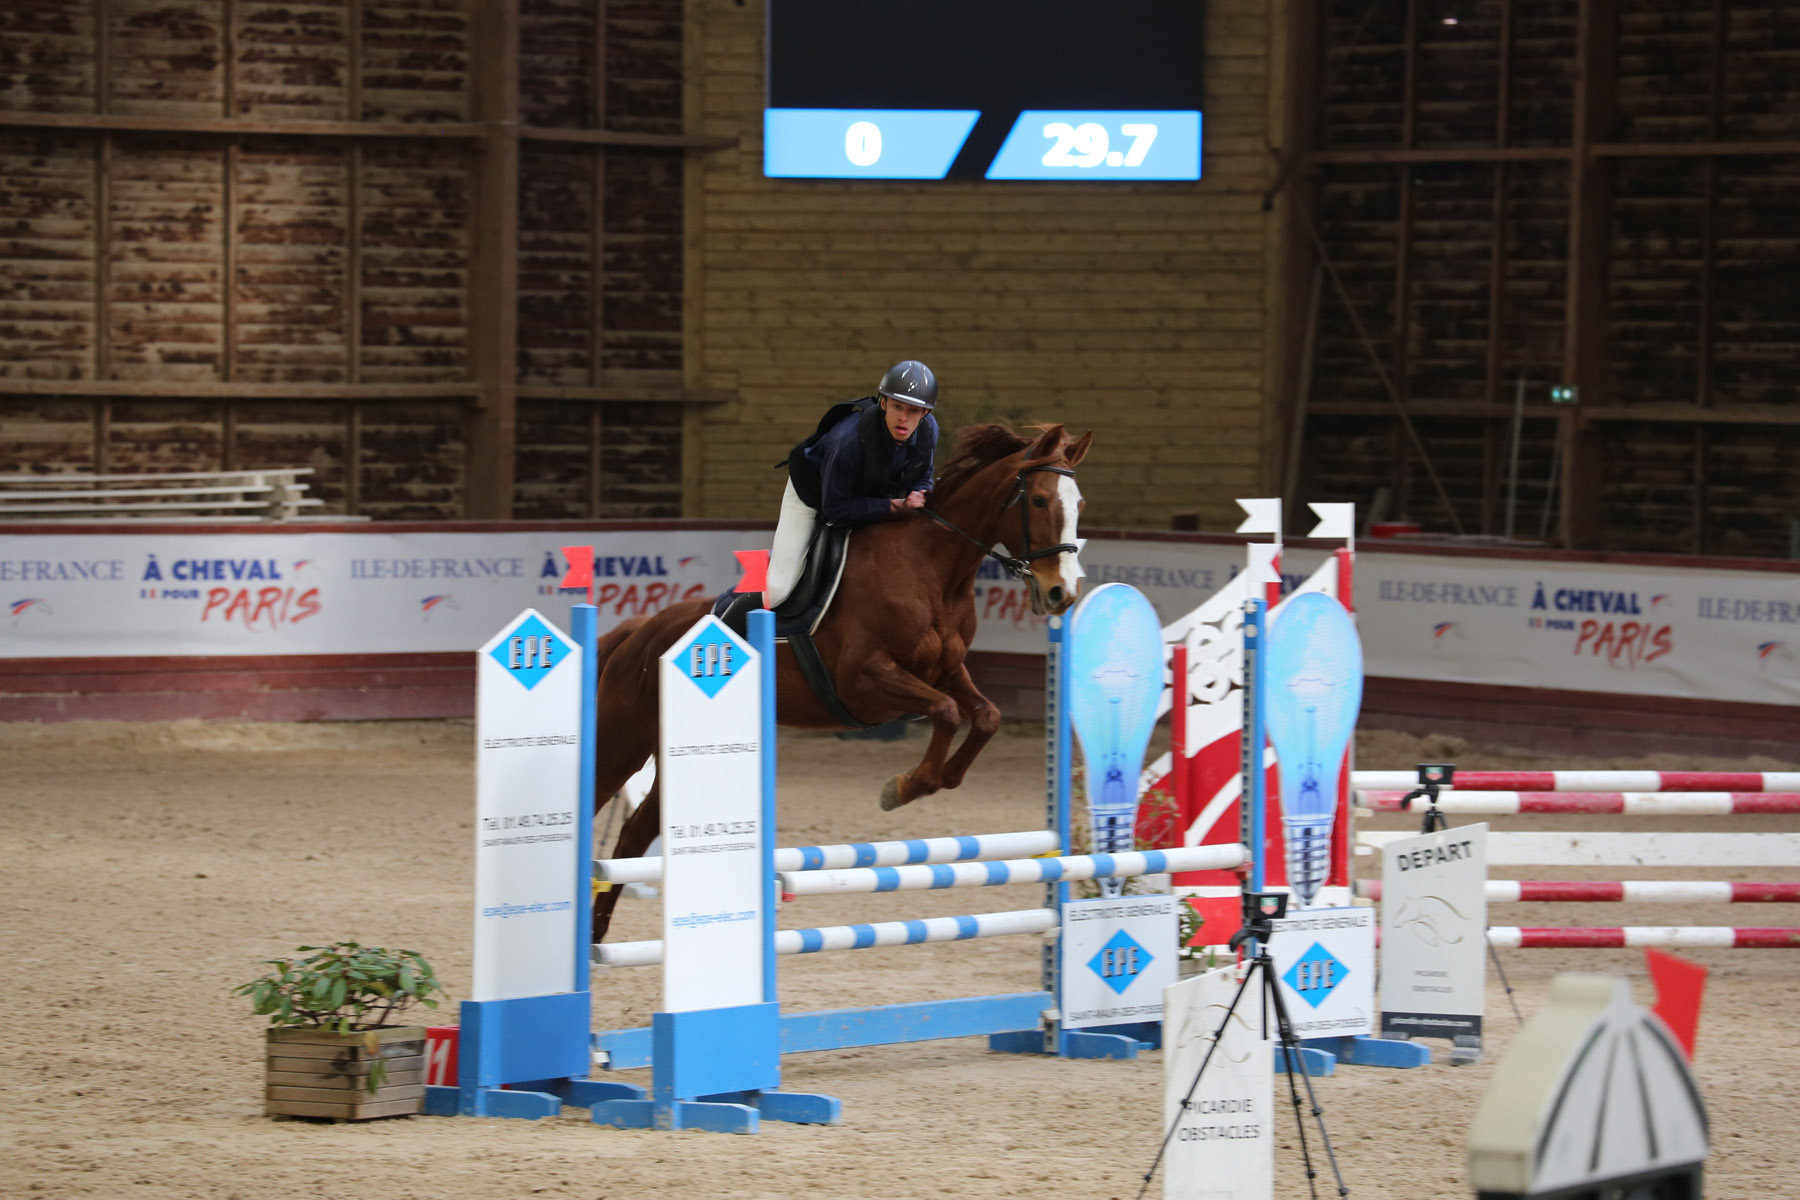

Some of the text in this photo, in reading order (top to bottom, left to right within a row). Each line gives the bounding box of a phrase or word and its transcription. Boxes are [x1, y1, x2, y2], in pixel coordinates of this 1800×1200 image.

[845, 121, 882, 166] 0
[1042, 122, 1158, 167] 29.7
[0, 560, 125, 580] E-FRANCE
[142, 554, 281, 581] À CHEVAL
[351, 557, 525, 579] ILE-DE-FRANCE
[541, 551, 668, 577] À HEVAL
[162, 587, 322, 631] POUR PARIS
[1379, 580, 1520, 607] ILE-DE-FRANCE
[1531, 581, 1641, 615] À CHEVAL
[1697, 597, 1800, 624] ILE-DE-FR
[508, 635, 553, 669] EPE
[1545, 619, 1674, 669] POUR PARIS
[690, 642, 732, 678] EPE
[1101, 946, 1139, 977] EPE
[1297, 959, 1335, 991] EPE
[1178, 1125, 1260, 1141] OBSTACLES
